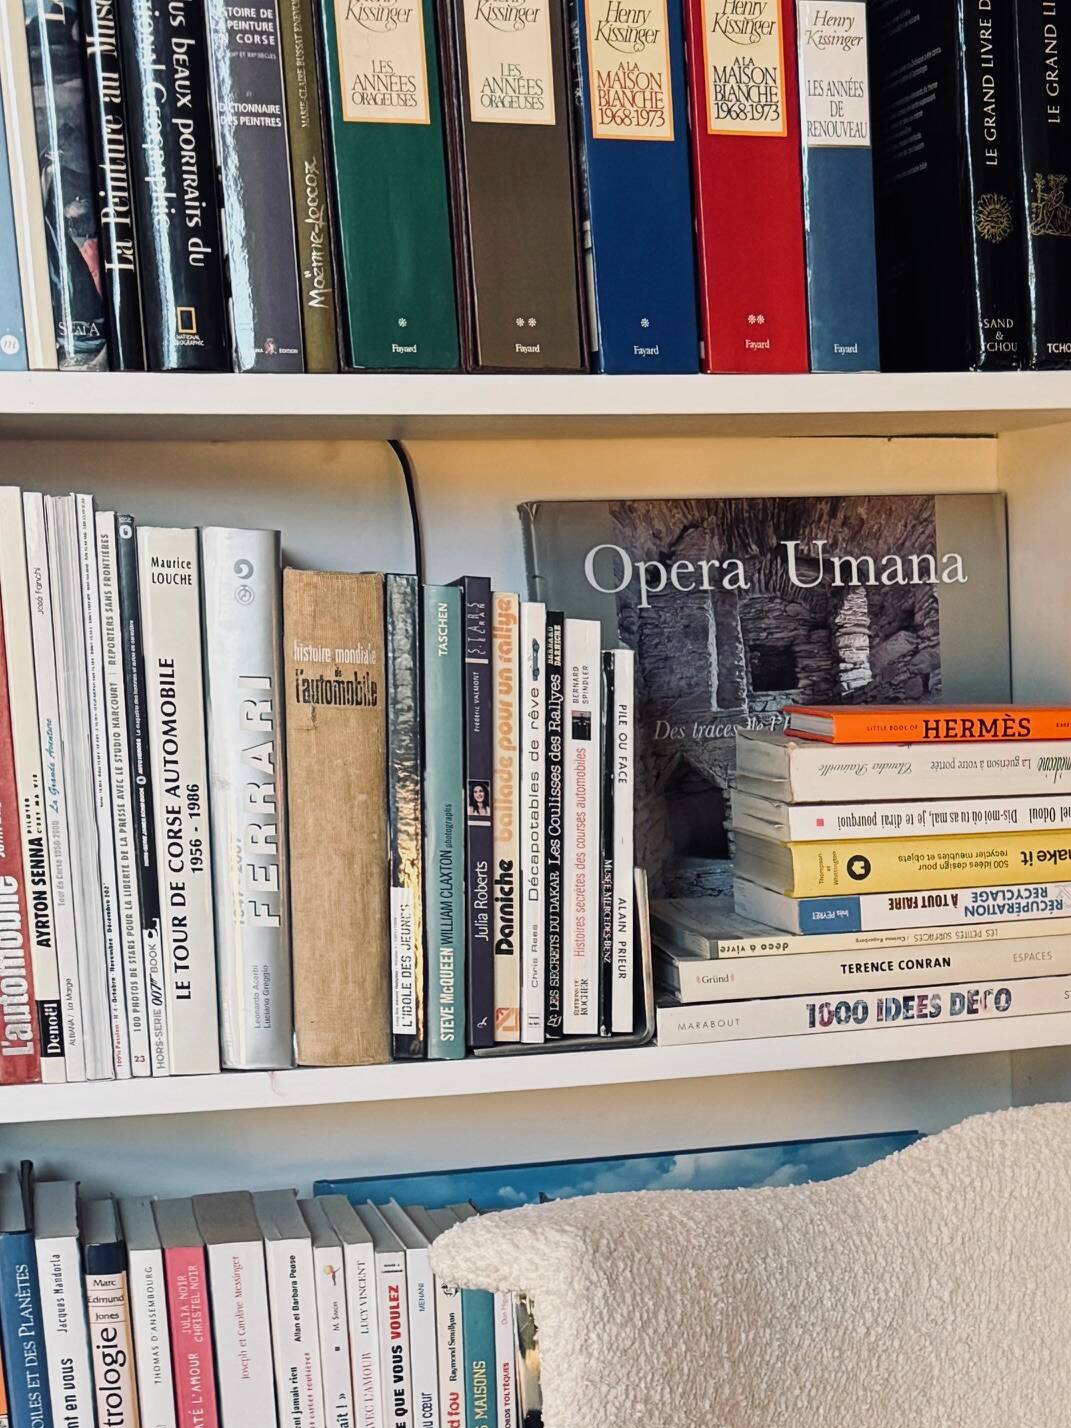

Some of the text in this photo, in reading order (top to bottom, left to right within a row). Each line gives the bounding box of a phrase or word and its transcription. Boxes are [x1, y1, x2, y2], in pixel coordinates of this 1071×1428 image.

[345, 0, 413, 32] Kissinger
[606, 0, 651, 27] Henry
[814, 10, 855, 30] Henry
[594, 20, 660, 53] Kissinger
[806, 28, 863, 50] Kissinger
[371, 60, 393, 74] LES
[597, 69, 661, 90] MAISON
[352, 72, 416, 92] ANNÉES
[807, 78, 863, 98] LES ANNÉES
[980, 19, 997, 165] LE GRAND LIVRE
[352, 92, 417, 107] ORAGEUSES
[598, 89, 664, 109] BLANCHE
[830, 102, 843, 117] DE
[599, 109, 665, 127] 1968-1973
[807, 121, 866, 139] RENOUVEAU
[99, 73, 134, 272] La Peinture au
[981, 319, 1013, 328] SAND
[392, 343, 417, 353] Fayard
[633, 346, 659, 356] Fayard
[834, 344, 857, 354] Fayard
[151, 557, 192, 569] Maurice
[584, 540, 968, 608] Opera Umana
[152, 573, 192, 585] LOUCHE
[438, 603, 448, 656] TASCHEN
[294, 640, 377, 665] histoire mondiale
[295, 668, 378, 707] l'automobile
[922, 713, 1031, 740] HERMÈS
[618, 705, 628, 784] PILE OU FACE
[547, 674, 564, 865] Les Coulisses des Rallyes
[238, 675, 280, 927] FERRARI
[527, 688, 542, 901] Décapotables de rêve
[159, 658, 192, 999] LE TOUR DE CORSE AUTOMOBILE
[1029, 807, 1056, 823] Odoul
[1020, 850, 1034, 867] it
[474, 861, 489, 941] Julia Roberts
[494, 860, 514, 955] Darniche
[889, 894, 947, 911] TOUT FAIRE
[970, 886, 1048, 904] RECYCLAGE
[29, 837, 61, 1055] Denoël AYRTON SENNA
[438, 850, 454, 1040] STEVE McQUEEN WILLIAM CLAXTON
[702, 956, 951, 985] Gründ TERENCE CONRAN
[678, 1018, 740, 1030] MARABOUT
[806, 1000, 869, 1028] 1000
[388, 1285, 402, 1339] VOULEZ
[60, 1358, 77, 1390] vous
[391, 1345, 405, 1383] VOUS
[64, 1394, 79, 1410] en
[393, 1388, 407, 1417] QUE
[473, 1361, 488, 1419] MAISONS
[448, 1392, 461, 1417] fou
